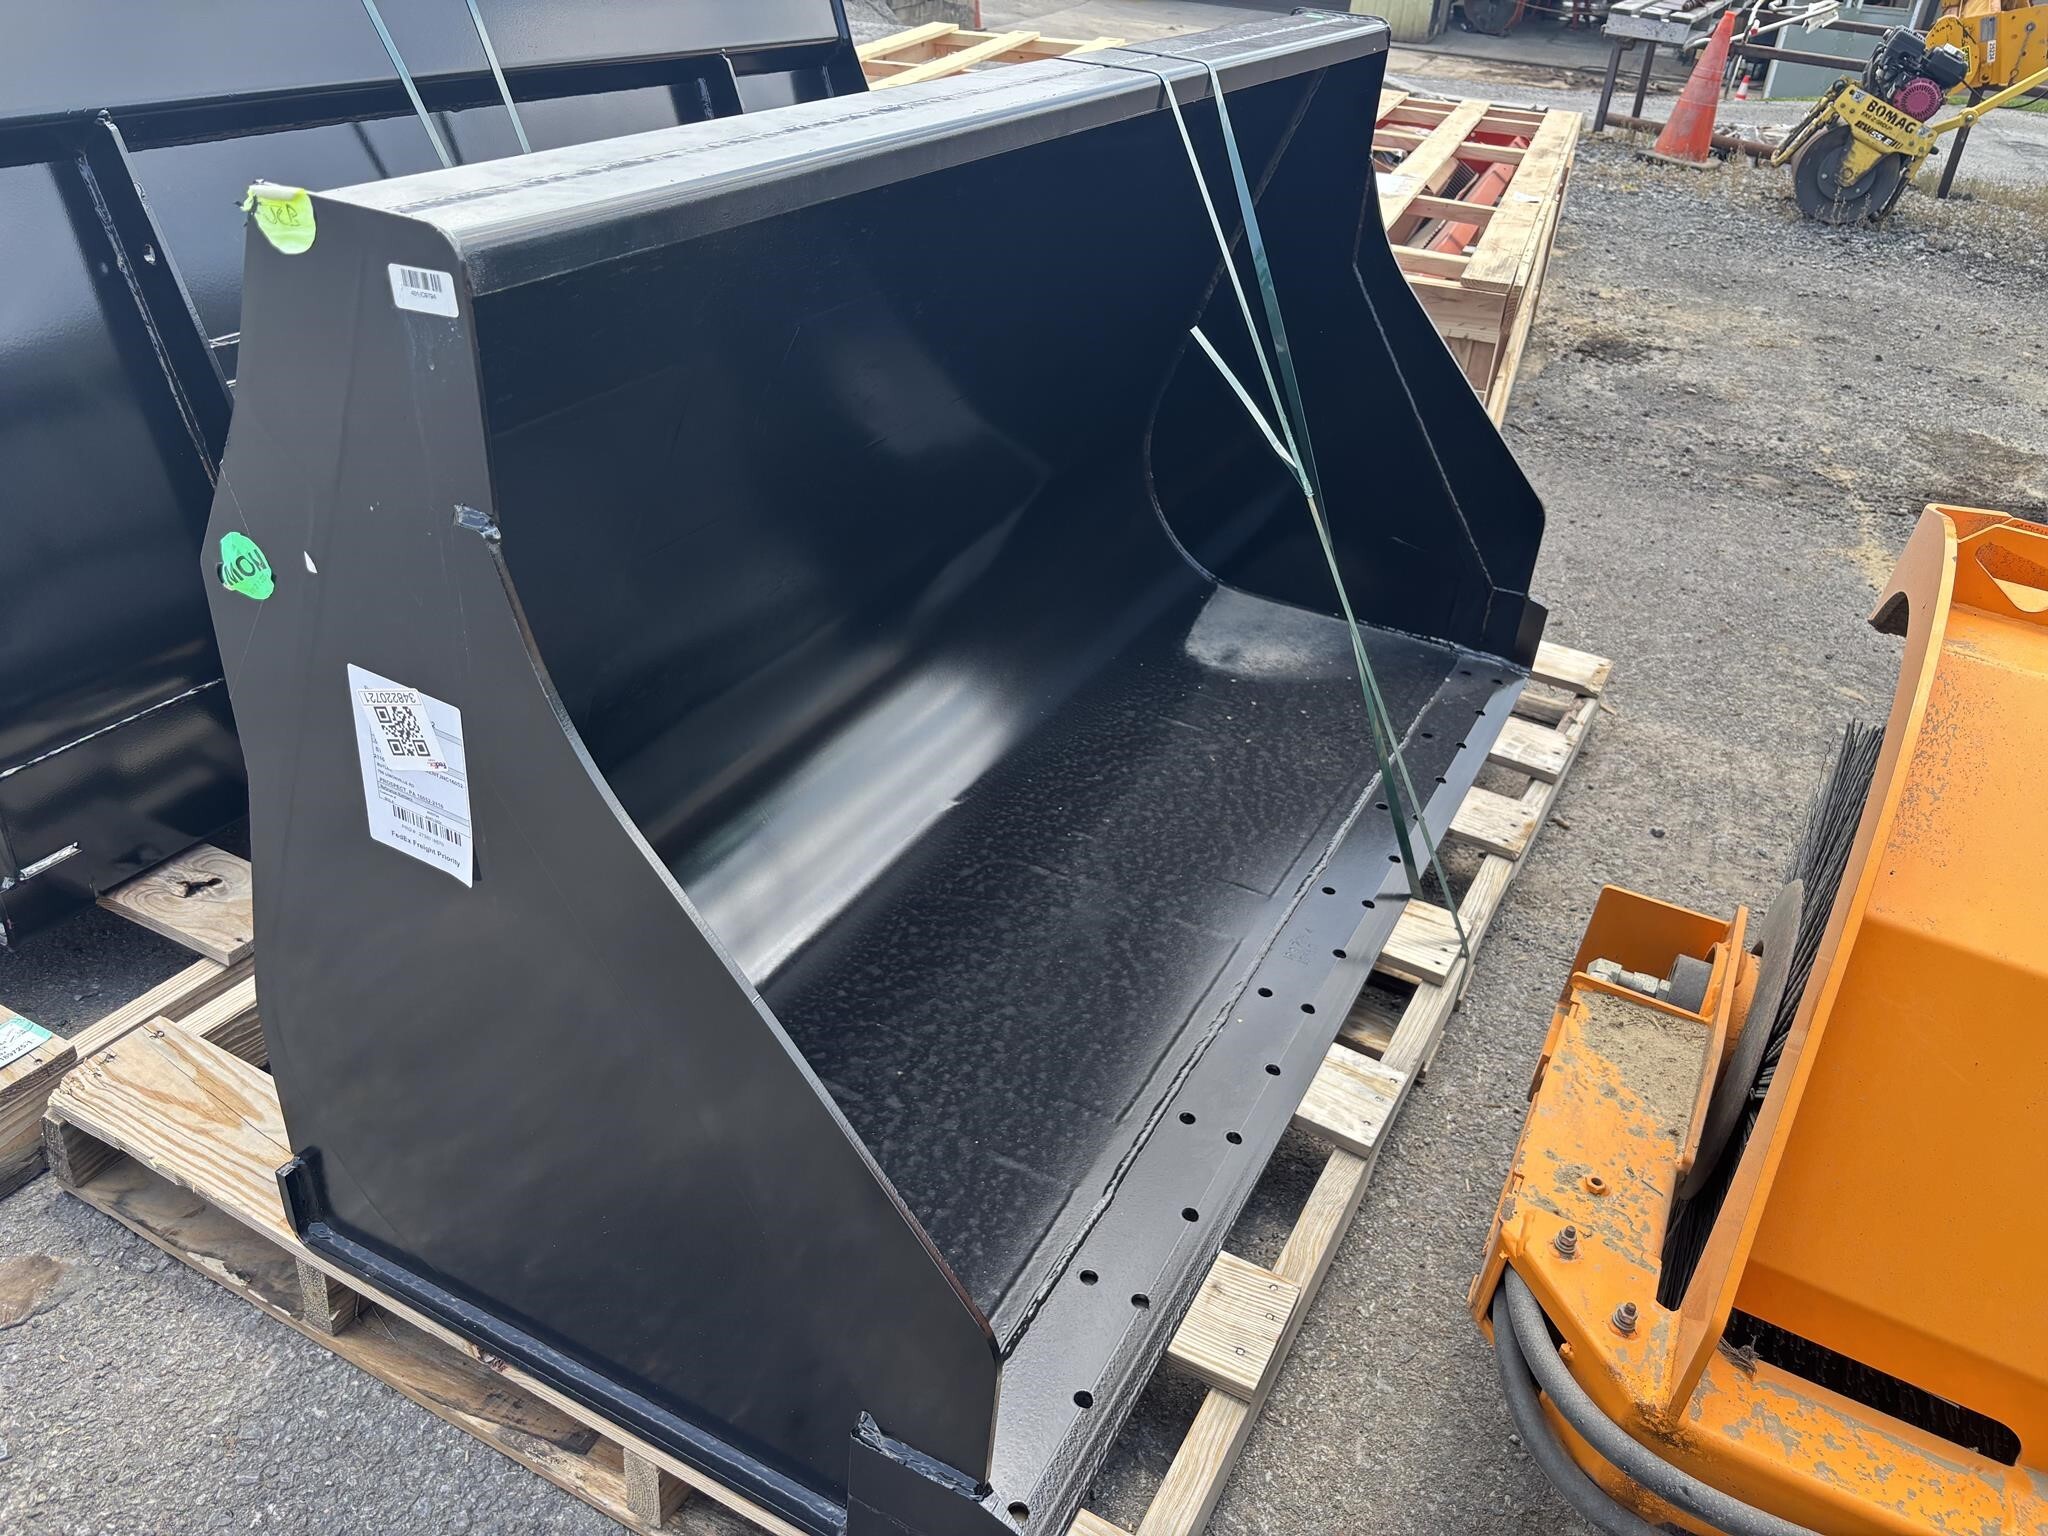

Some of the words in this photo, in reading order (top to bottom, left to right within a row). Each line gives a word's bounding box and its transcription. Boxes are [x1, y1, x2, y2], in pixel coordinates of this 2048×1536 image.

[1866, 99, 1917, 134] BOMAG
[363, 692, 417, 704] 348220721
[391, 830, 411, 844] FedEx
[412, 839, 436, 856] Freight
[437, 850, 461, 868] Priority
